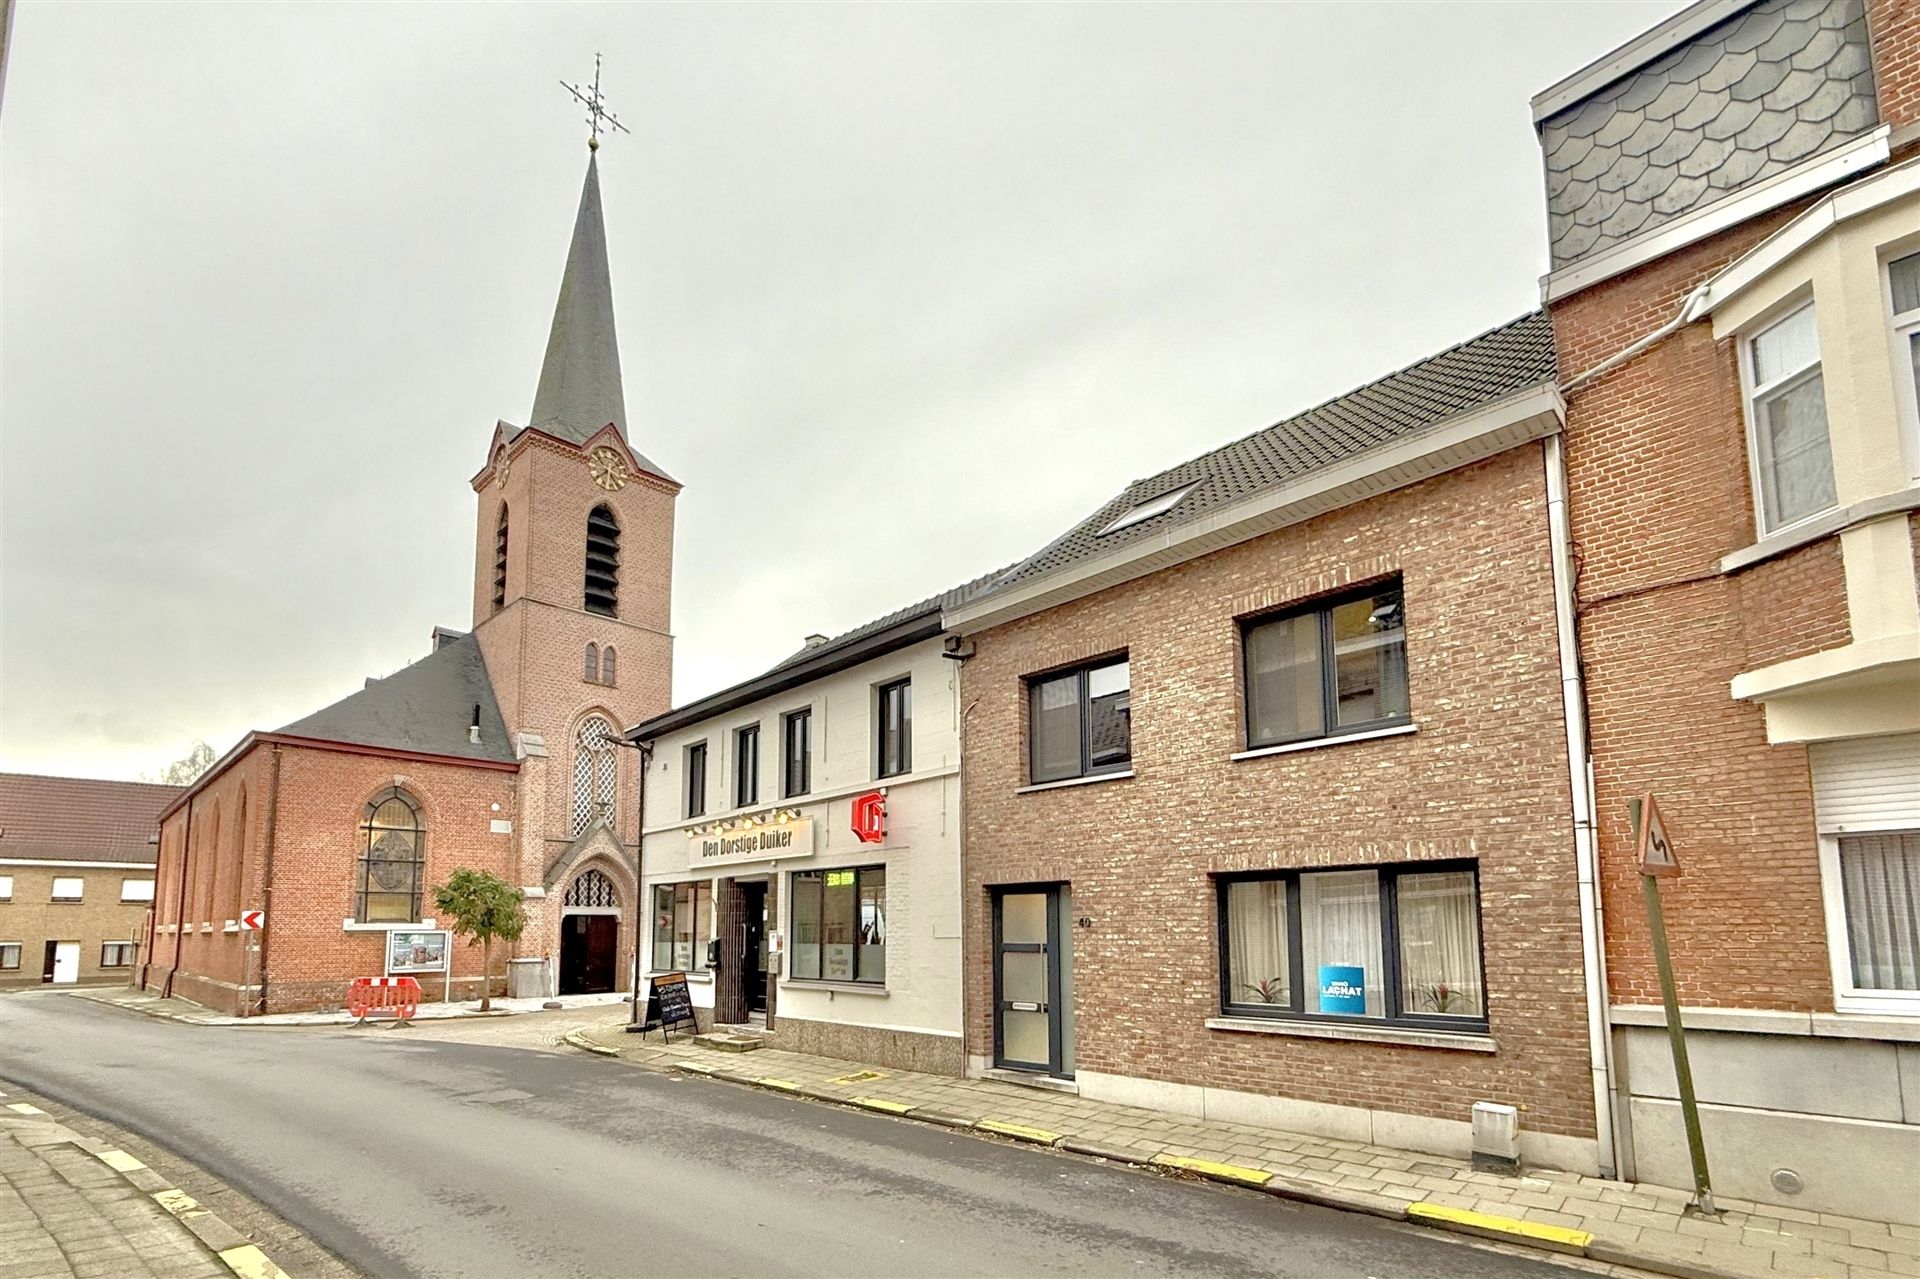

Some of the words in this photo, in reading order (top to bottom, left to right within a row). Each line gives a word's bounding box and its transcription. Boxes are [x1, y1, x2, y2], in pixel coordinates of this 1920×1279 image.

[703, 840, 719, 857] Den
[720, 834, 758, 854] Dorstige
[760, 830, 793, 850] Duiker
[1079, 917, 1091, 928] 40
[1322, 985, 1362, 996] LACHAT
